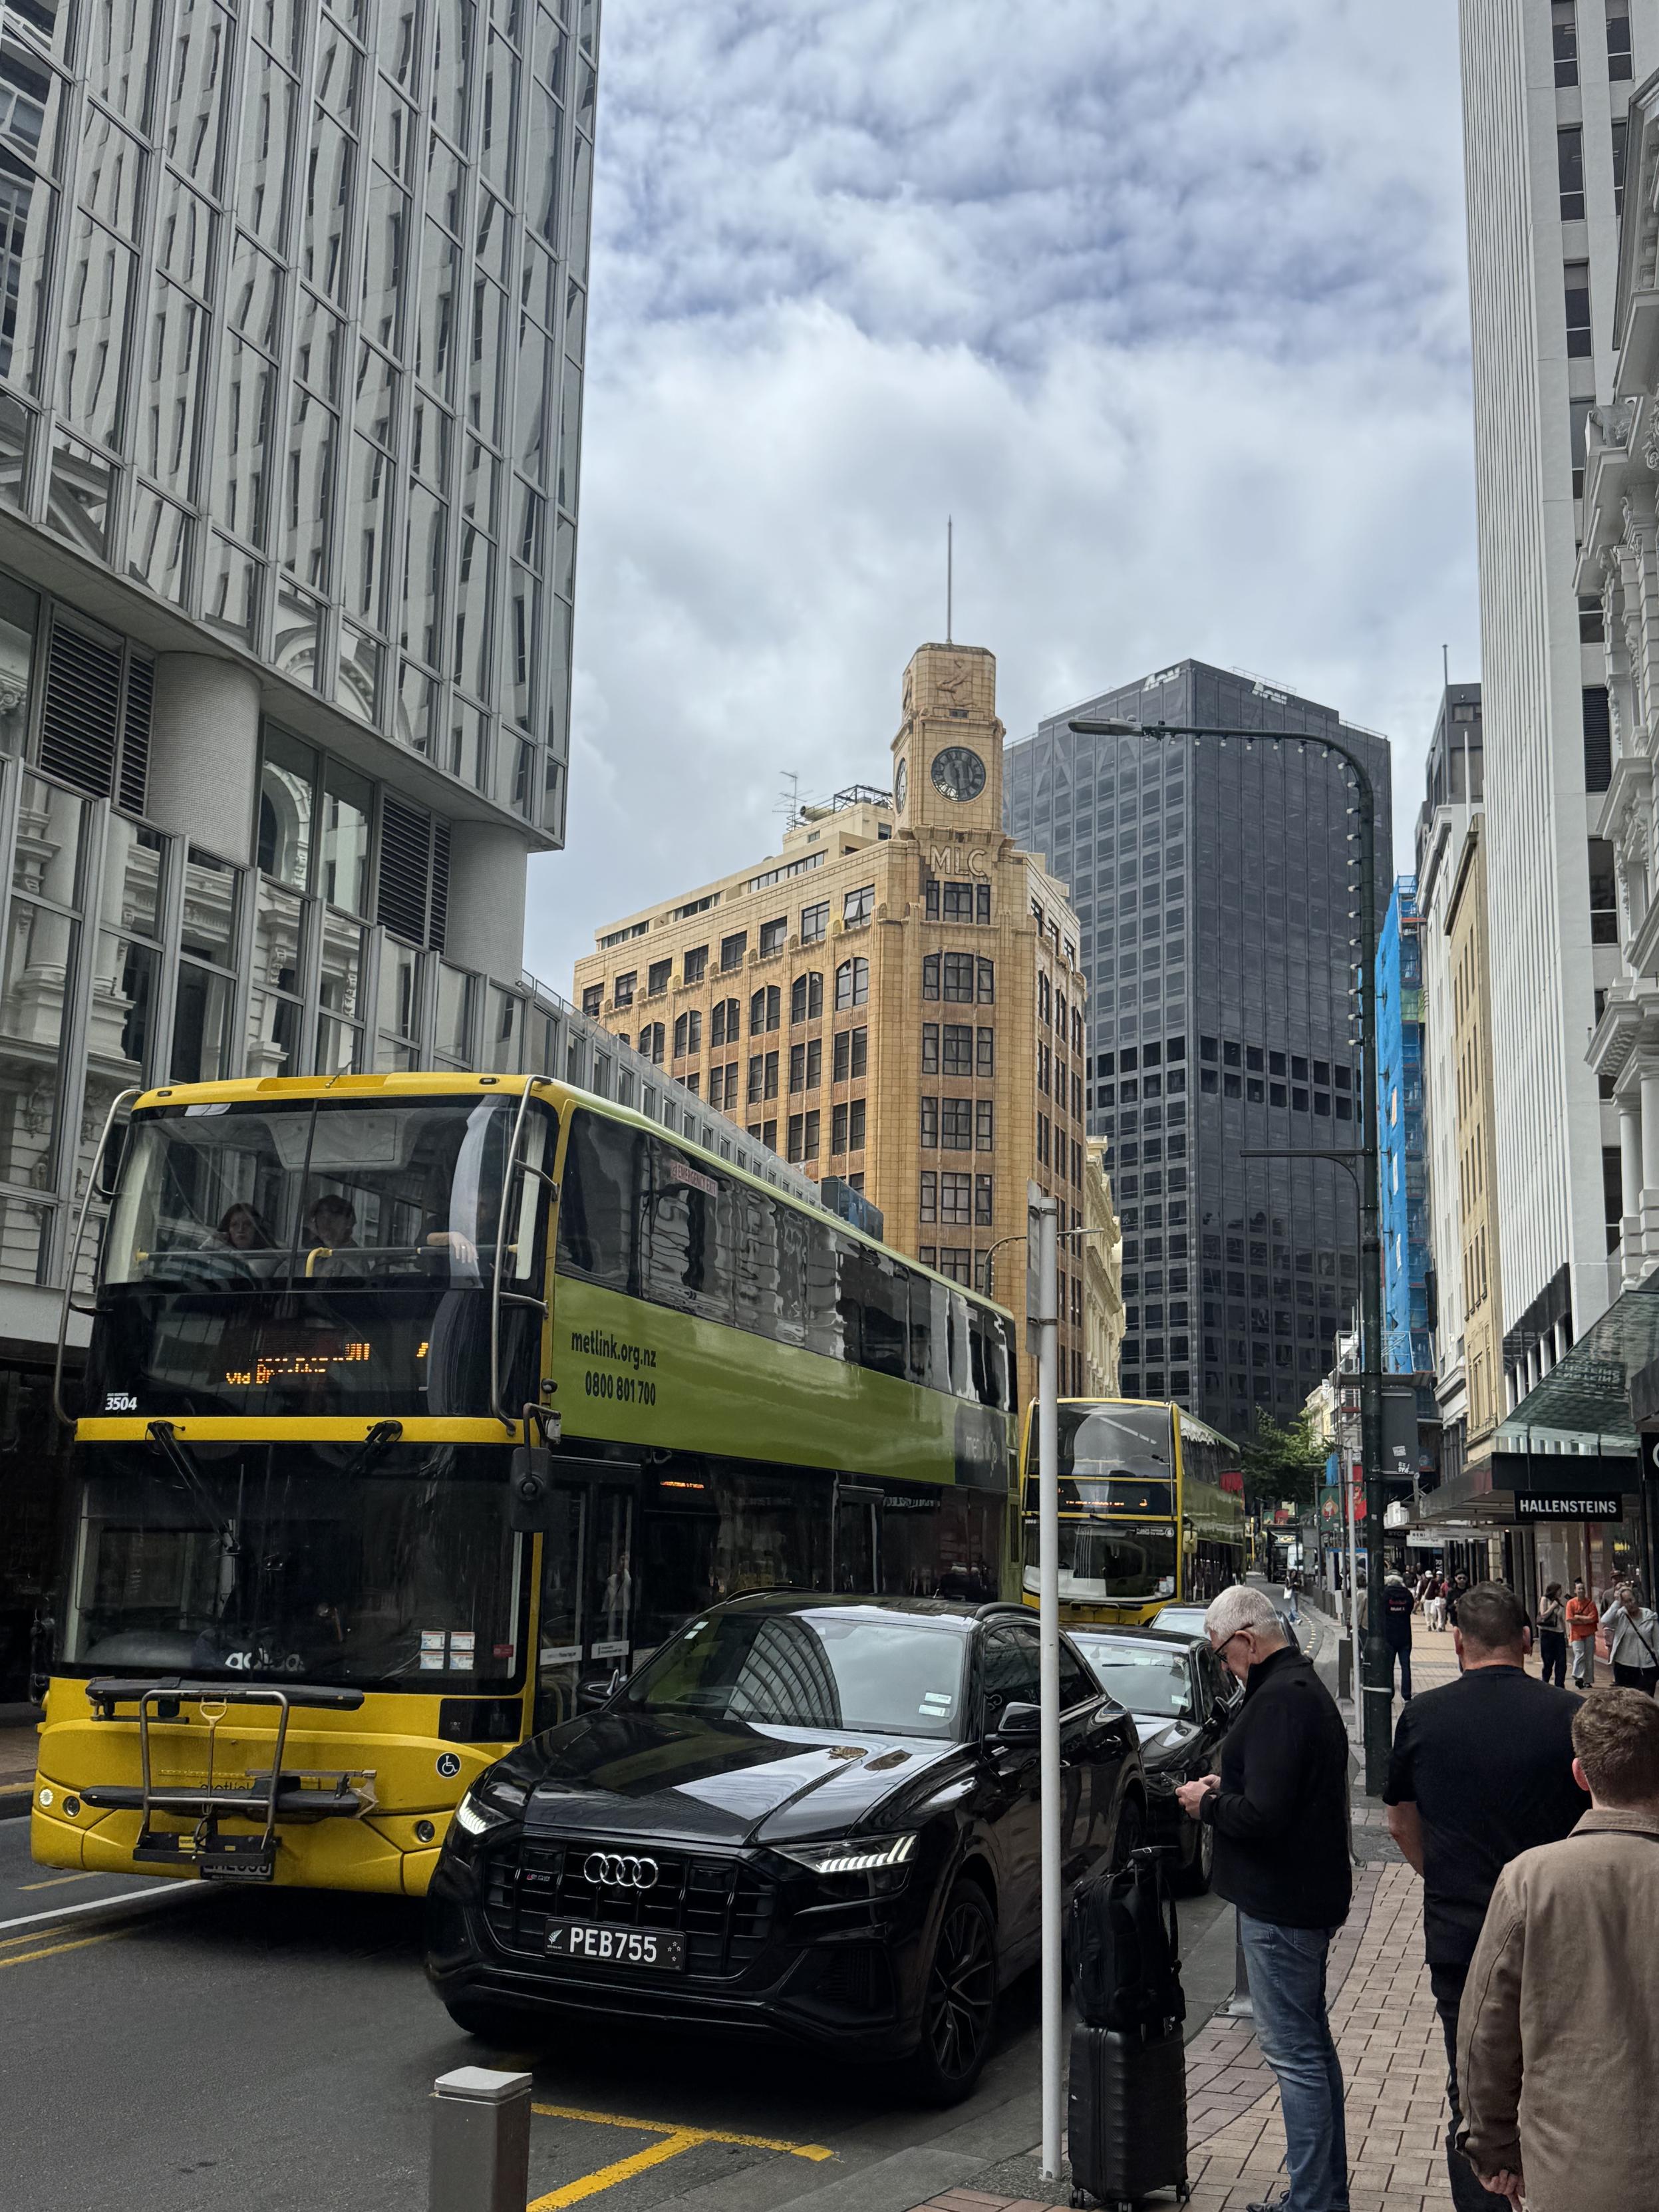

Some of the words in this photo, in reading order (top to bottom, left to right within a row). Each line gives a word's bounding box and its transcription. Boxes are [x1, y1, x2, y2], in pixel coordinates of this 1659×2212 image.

[931, 845, 986, 877] MLC
[571, 1330, 657, 1370] metlink.org.nz
[105, 1397, 137, 1410] 3504
[585, 1370, 613, 1399] 0800
[617, 1376, 635, 1403] 801
[638, 1380, 656, 1406] 700
[1520, 1500, 1616, 1513] HALLENSTEINS
[569, 1927, 657, 1963] PEB755
